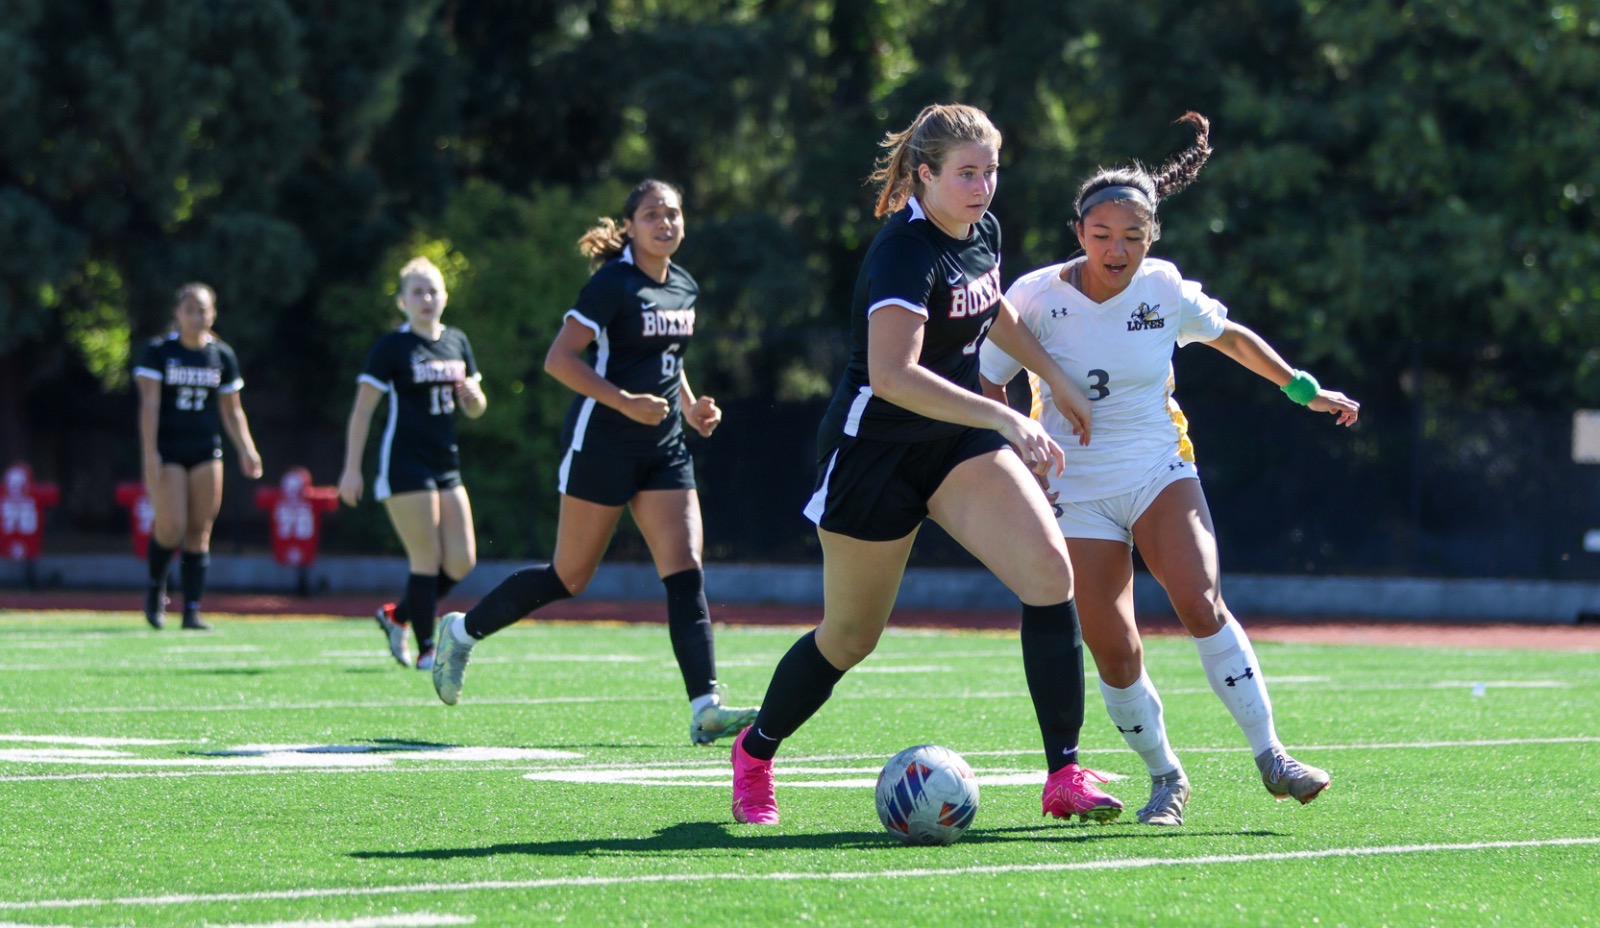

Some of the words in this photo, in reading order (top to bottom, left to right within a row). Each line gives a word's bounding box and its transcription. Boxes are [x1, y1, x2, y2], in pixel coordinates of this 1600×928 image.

[1127, 318, 1164, 331] LUTES
[661, 343, 680, 377] 6
[1087, 369, 1110, 401] 3
[177, 388, 208, 411] 27
